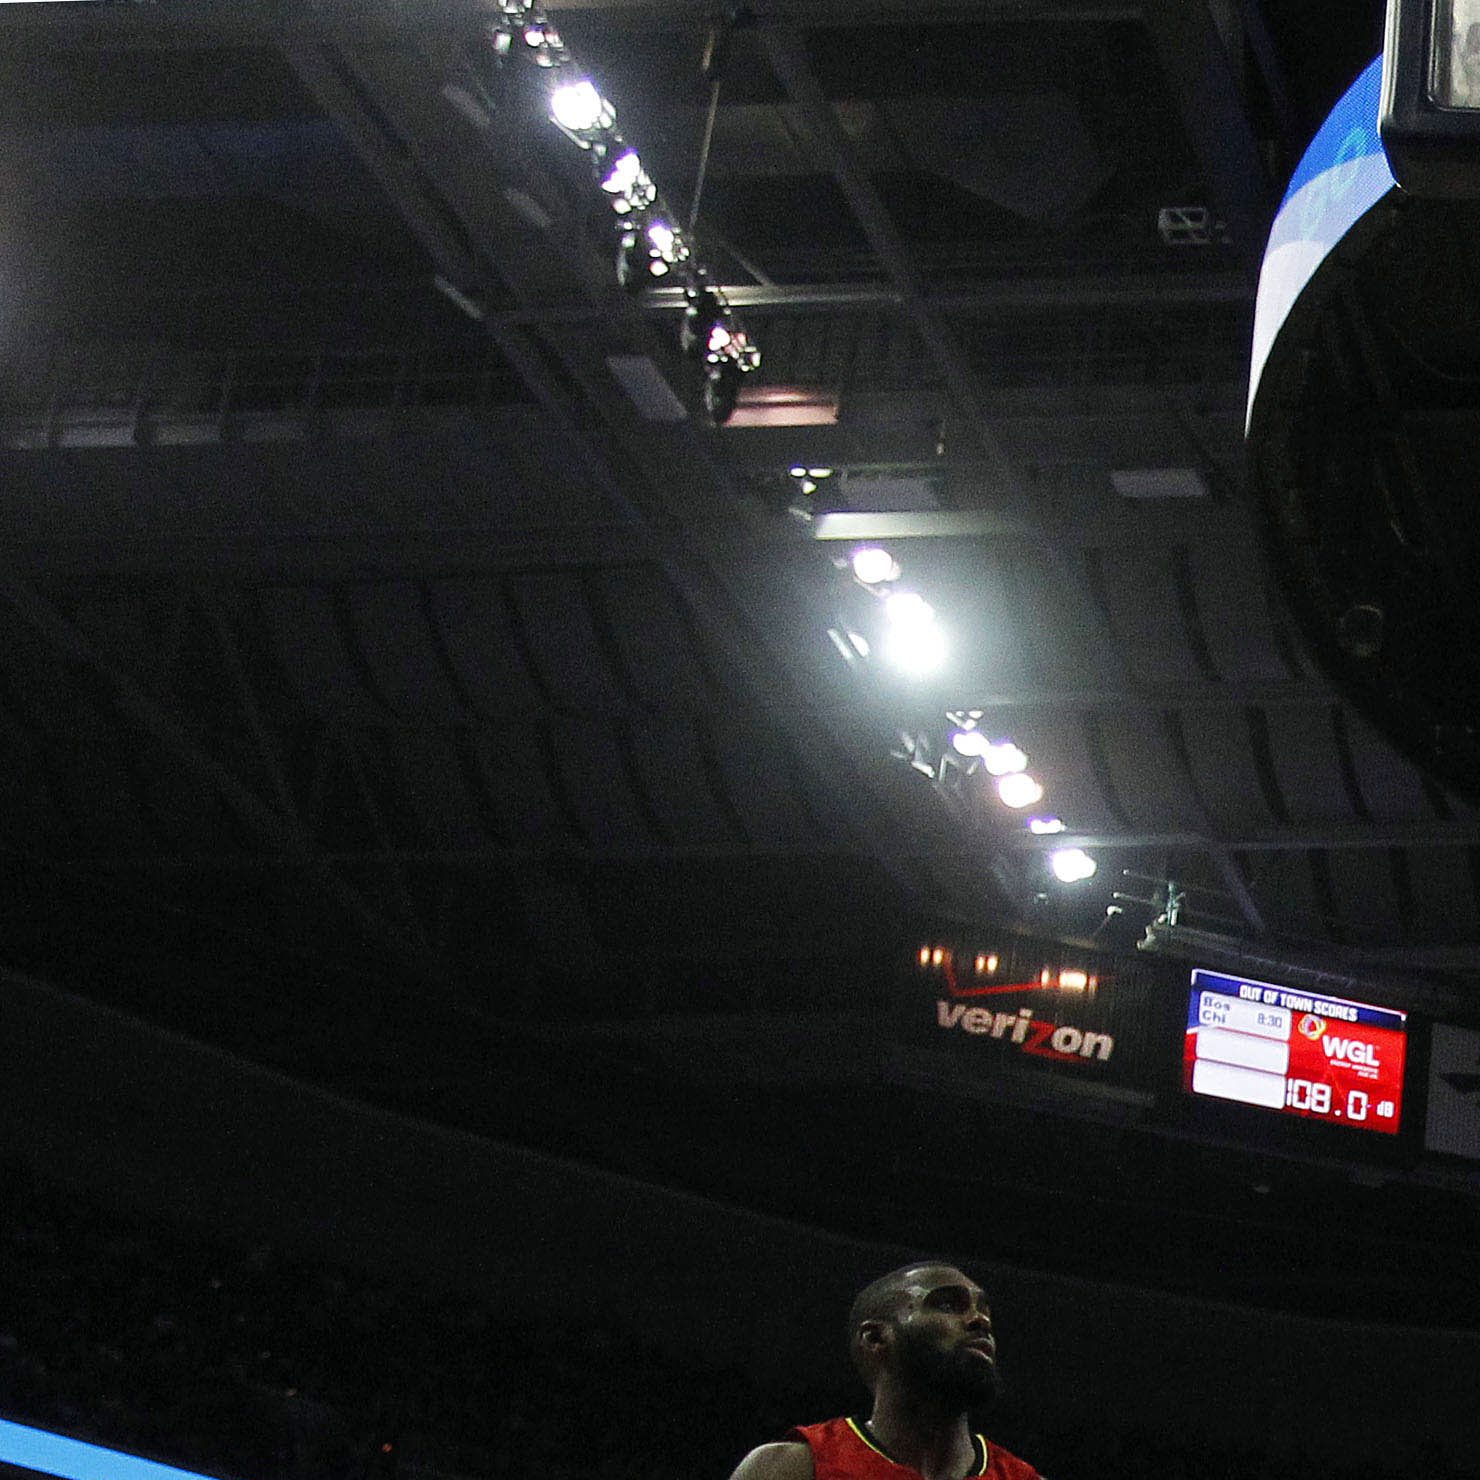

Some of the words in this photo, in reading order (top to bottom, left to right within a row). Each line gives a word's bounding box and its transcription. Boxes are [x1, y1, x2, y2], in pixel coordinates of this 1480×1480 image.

[1202, 1010, 1226, 1024] Chi
[1257, 1012, 1283, 1029] 8:30
[1239, 985, 1263, 1001] OUT
[1263, 989, 1281, 1004] OF
[1280, 993, 1313, 1013] TOWN
[1314, 1000, 1358, 1022] SCORES
[936, 1000, 1115, 1063] verizon
[1322, 1034, 1380, 1067] WGL
